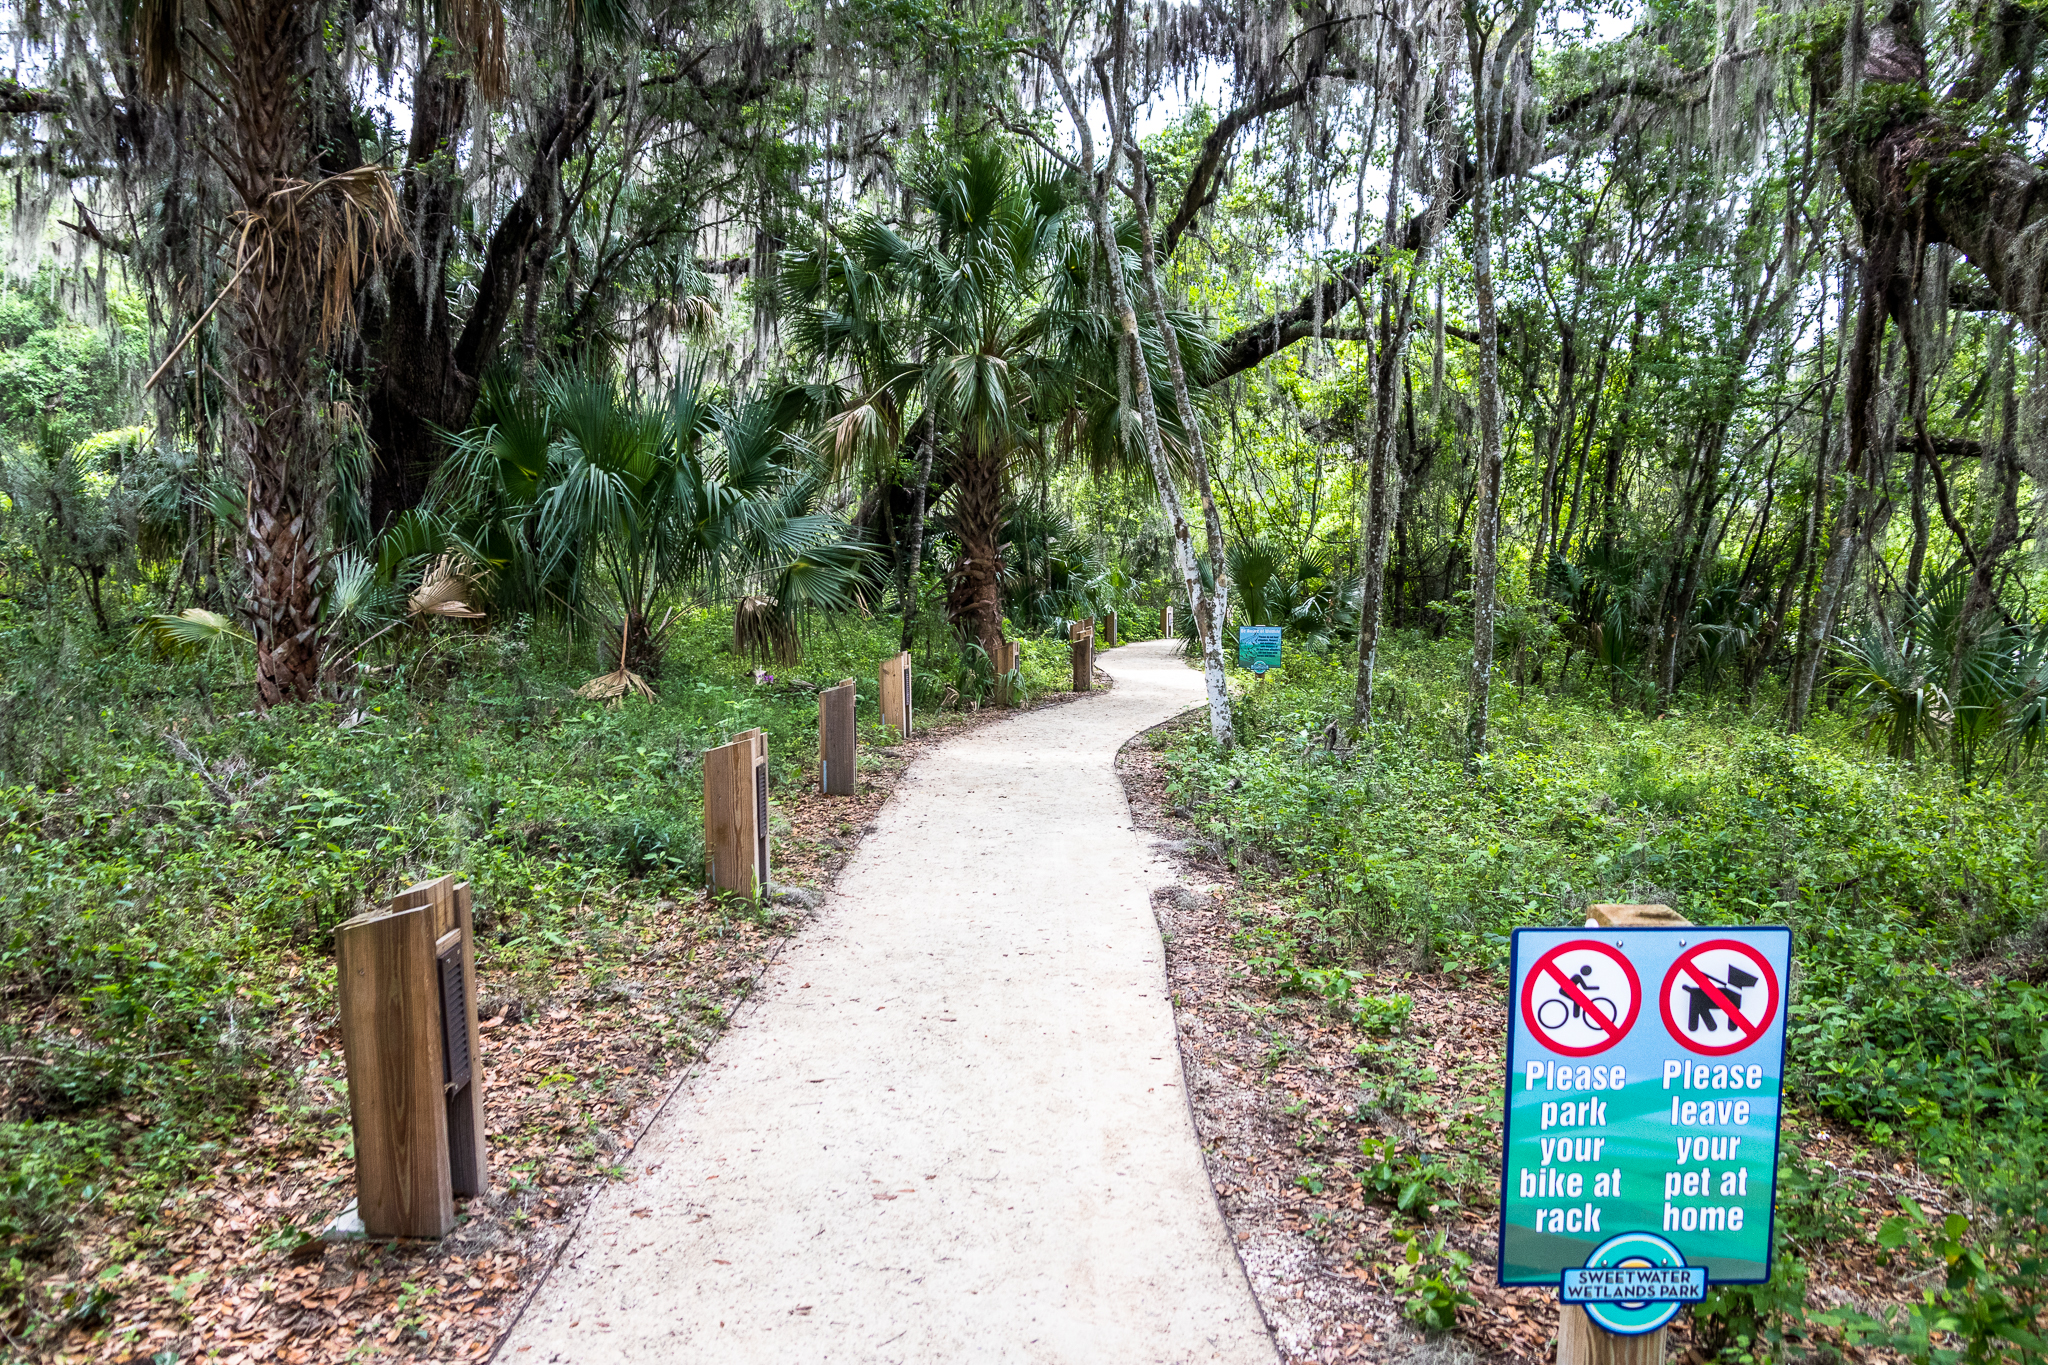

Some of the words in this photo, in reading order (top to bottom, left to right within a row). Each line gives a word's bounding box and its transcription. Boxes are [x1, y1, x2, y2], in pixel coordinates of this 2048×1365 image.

[1525, 1060, 1626, 1091] Please
[1662, 1059, 1763, 1090] Please
[1540, 1096, 1607, 1130] park
[1670, 1095, 1750, 1126] leave
[1540, 1137, 1605, 1166] your
[1676, 1136, 1741, 1165] your
[1519, 1167, 1583, 1198] bike
[1593, 1168, 1622, 1197] at
[1664, 1166, 1711, 1200] pet
[1719, 1166, 1748, 1196] at
[1535, 1202, 1601, 1233] rack
[1662, 1201, 1744, 1231] home
[1567, 1285, 1656, 1298] WETLANDS
[1660, 1285, 1700, 1297] PARK
[1578, 1270, 1691, 1284] SWEETWATER
